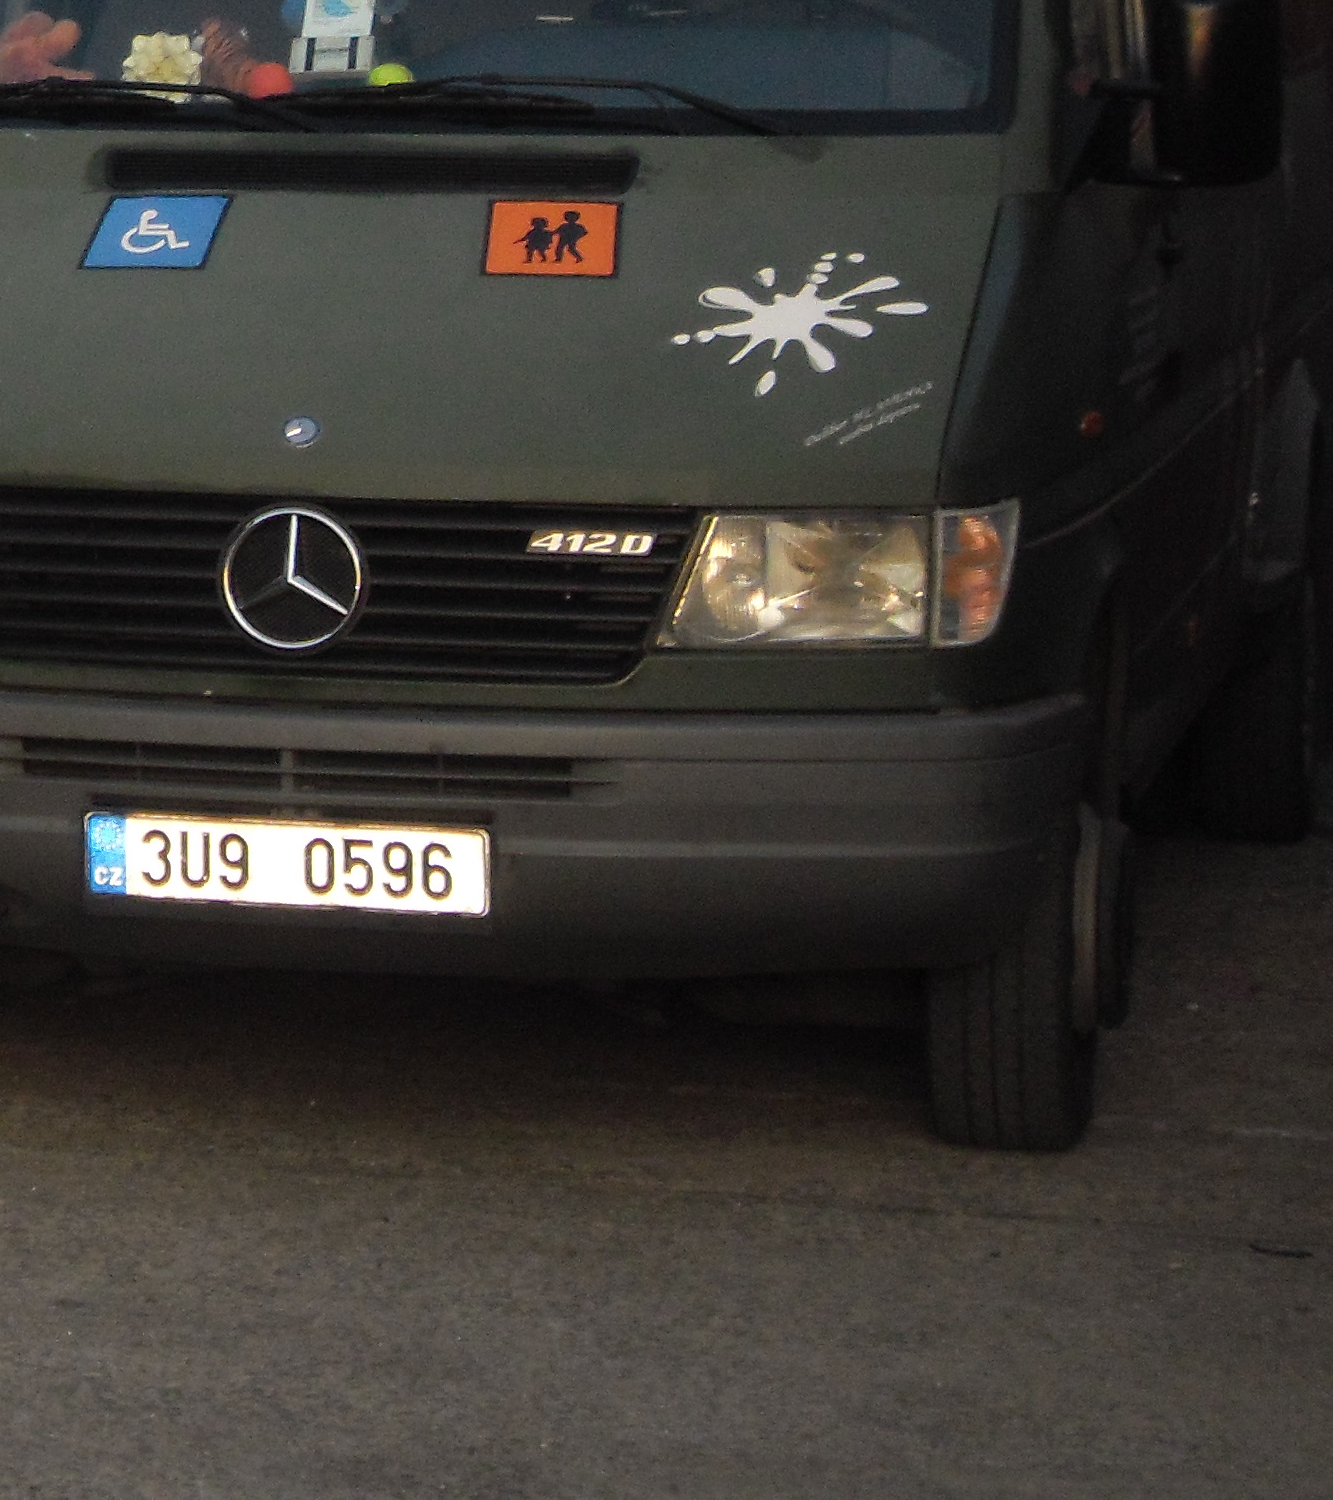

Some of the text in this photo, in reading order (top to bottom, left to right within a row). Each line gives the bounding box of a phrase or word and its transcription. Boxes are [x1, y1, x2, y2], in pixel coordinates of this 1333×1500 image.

[94, 829, 453, 900] CZ 3U9 0596
